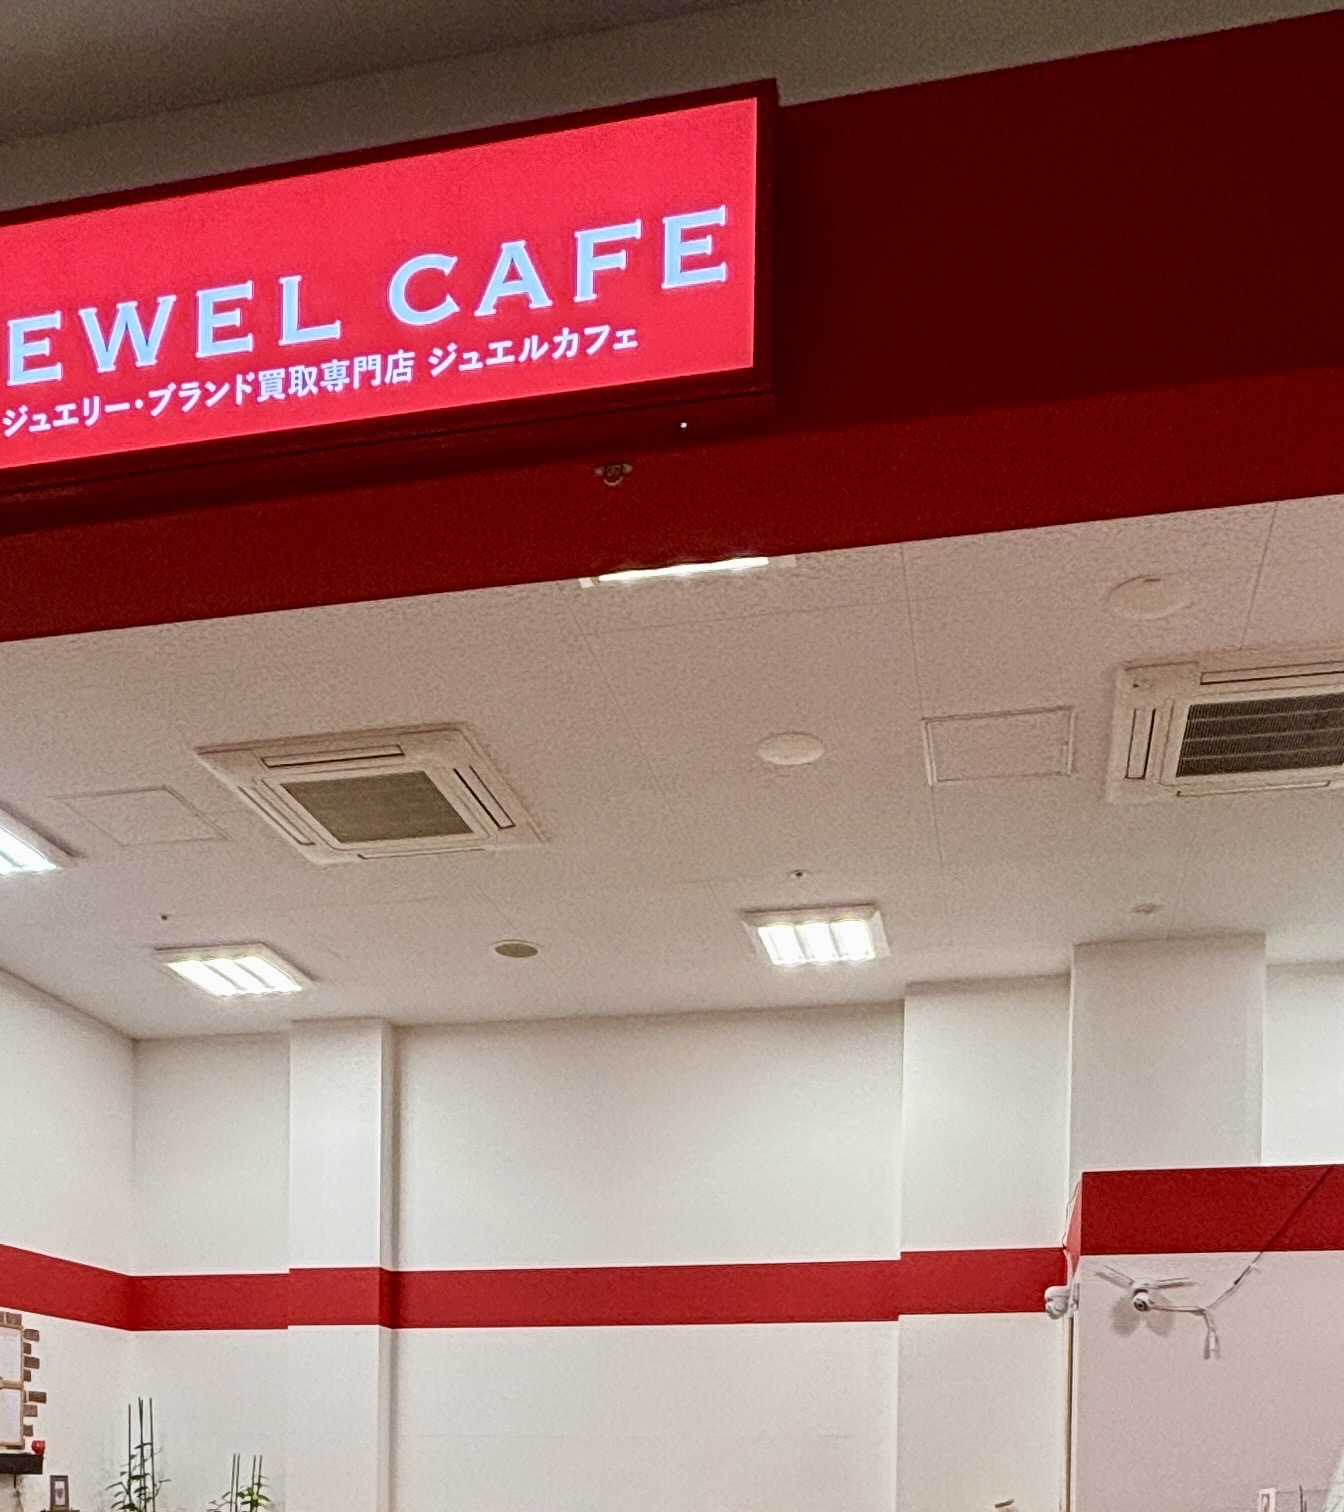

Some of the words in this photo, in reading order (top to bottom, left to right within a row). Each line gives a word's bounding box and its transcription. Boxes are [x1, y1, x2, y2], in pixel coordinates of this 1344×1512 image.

[388, 204, 728, 327] CAFE
[1, 351, 414, 440] ジュエリー・ブランド買取専門店
[429, 324, 638, 379] ジュエルカフェ
